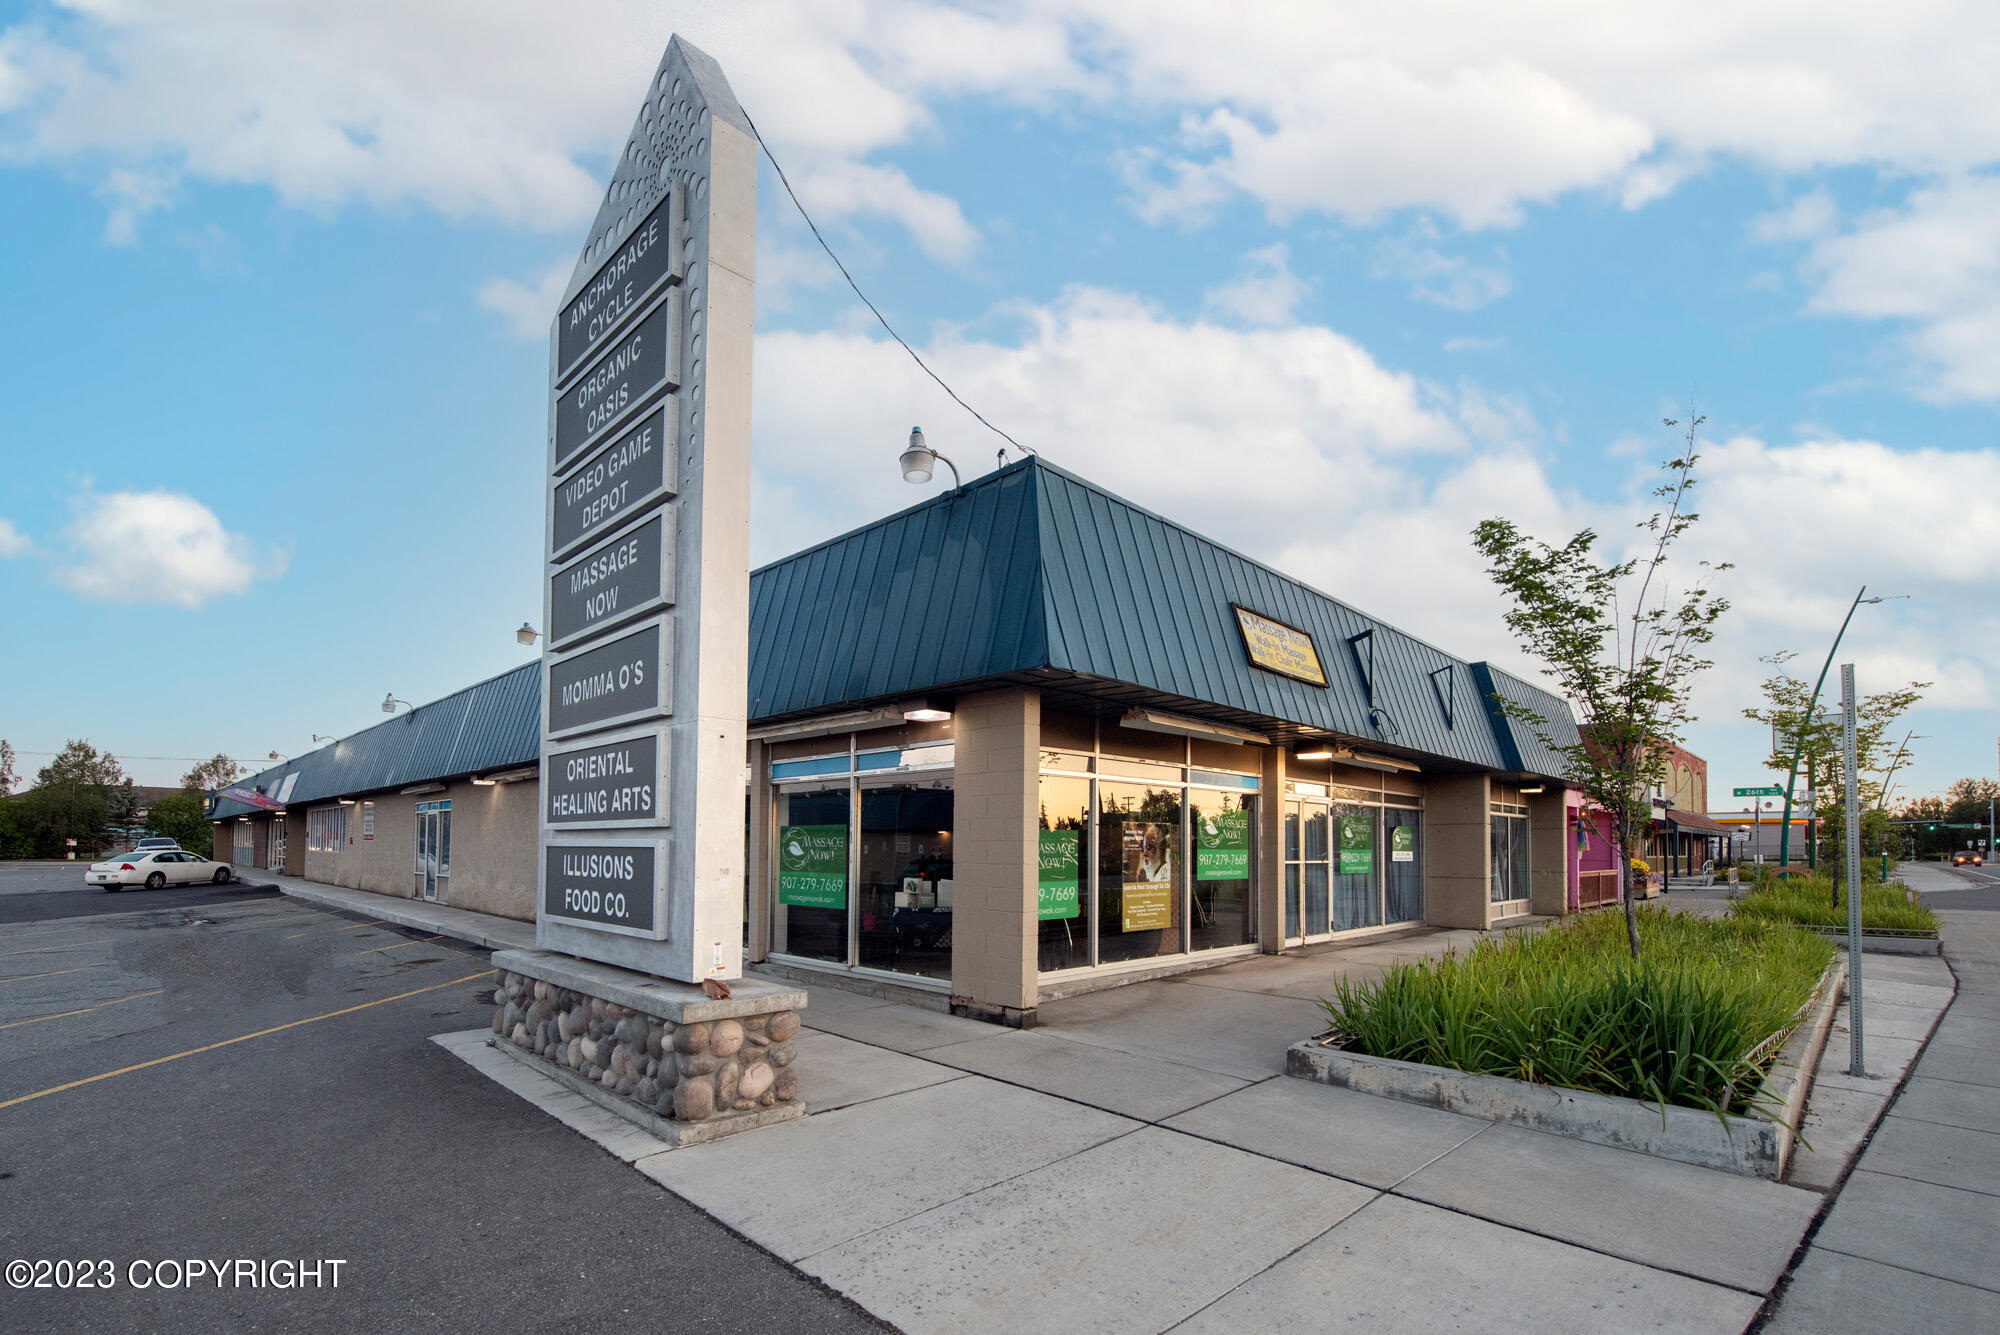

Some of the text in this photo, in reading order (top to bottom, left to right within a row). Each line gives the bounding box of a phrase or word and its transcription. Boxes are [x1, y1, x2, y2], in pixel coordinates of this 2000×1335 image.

[570, 219, 658, 330] ANCHORAGE
[588, 281, 632, 341] CYCLE
[578, 336, 641, 408] ORGANIC
[587, 382, 629, 433] OASIS
[566, 428, 652, 507] VIDEO GAME
[583, 480, 629, 528] DEPOT
[571, 539, 638, 594] MASSAGE
[586, 586, 619, 621] NOW
[562, 660, 644, 707] MOMMA O'S
[567, 750, 633, 781] ORIENTAL
[553, 785, 651, 816] HEALING ARTS
[1216, 816, 1247, 829] MASSAGE
[803, 836, 844, 849] MASSAGE
[809, 849, 834, 860] NOW!
[1039, 843, 1075, 854] ASSAGE
[563, 854, 633, 880] ILLUSIONS
[1199, 854, 1247, 866] 907-279-7669
[781, 876, 844, 892] 907-279-7669
[1039, 886, 1076, 902] 9-7669
[565, 888, 629, 918] FOOD CO.
